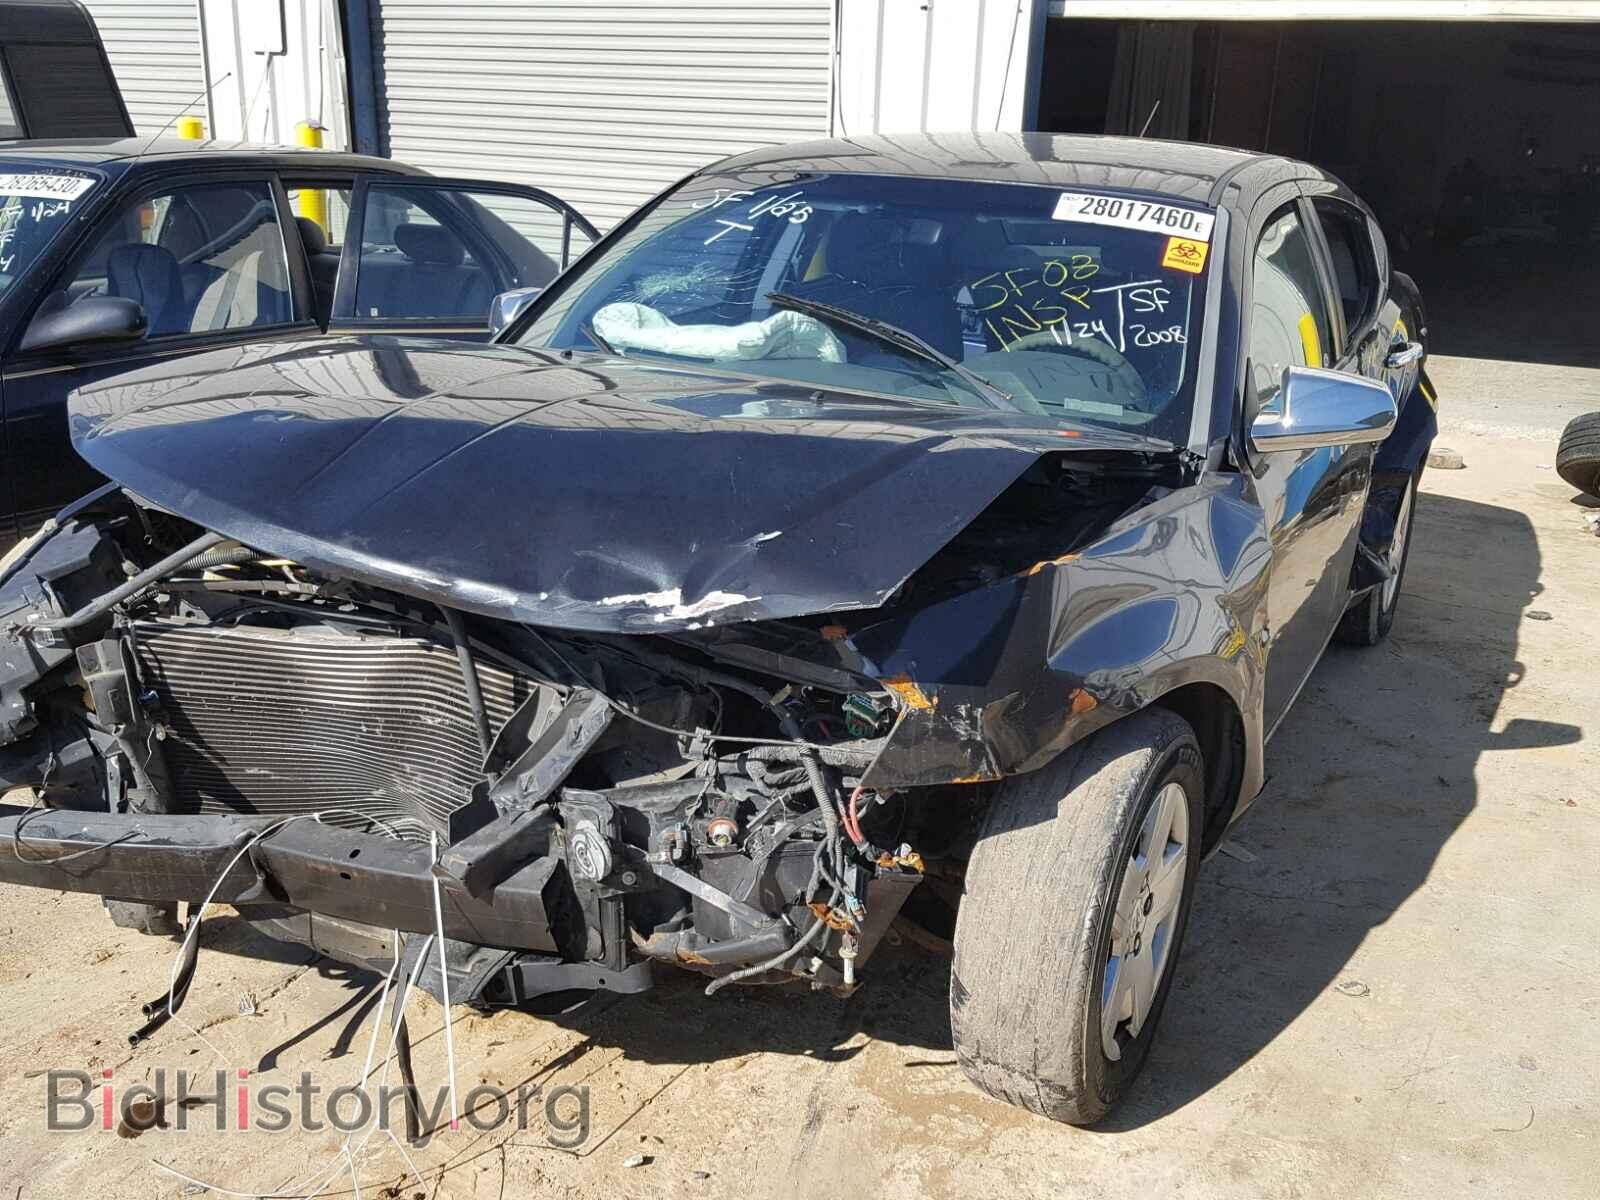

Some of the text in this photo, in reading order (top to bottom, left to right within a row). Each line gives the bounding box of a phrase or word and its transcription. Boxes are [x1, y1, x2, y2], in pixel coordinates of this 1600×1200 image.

[1078, 196, 1196, 230] 28017460
[1129, 288, 1171, 313] SF
[1129, 324, 1188, 347] 2008
